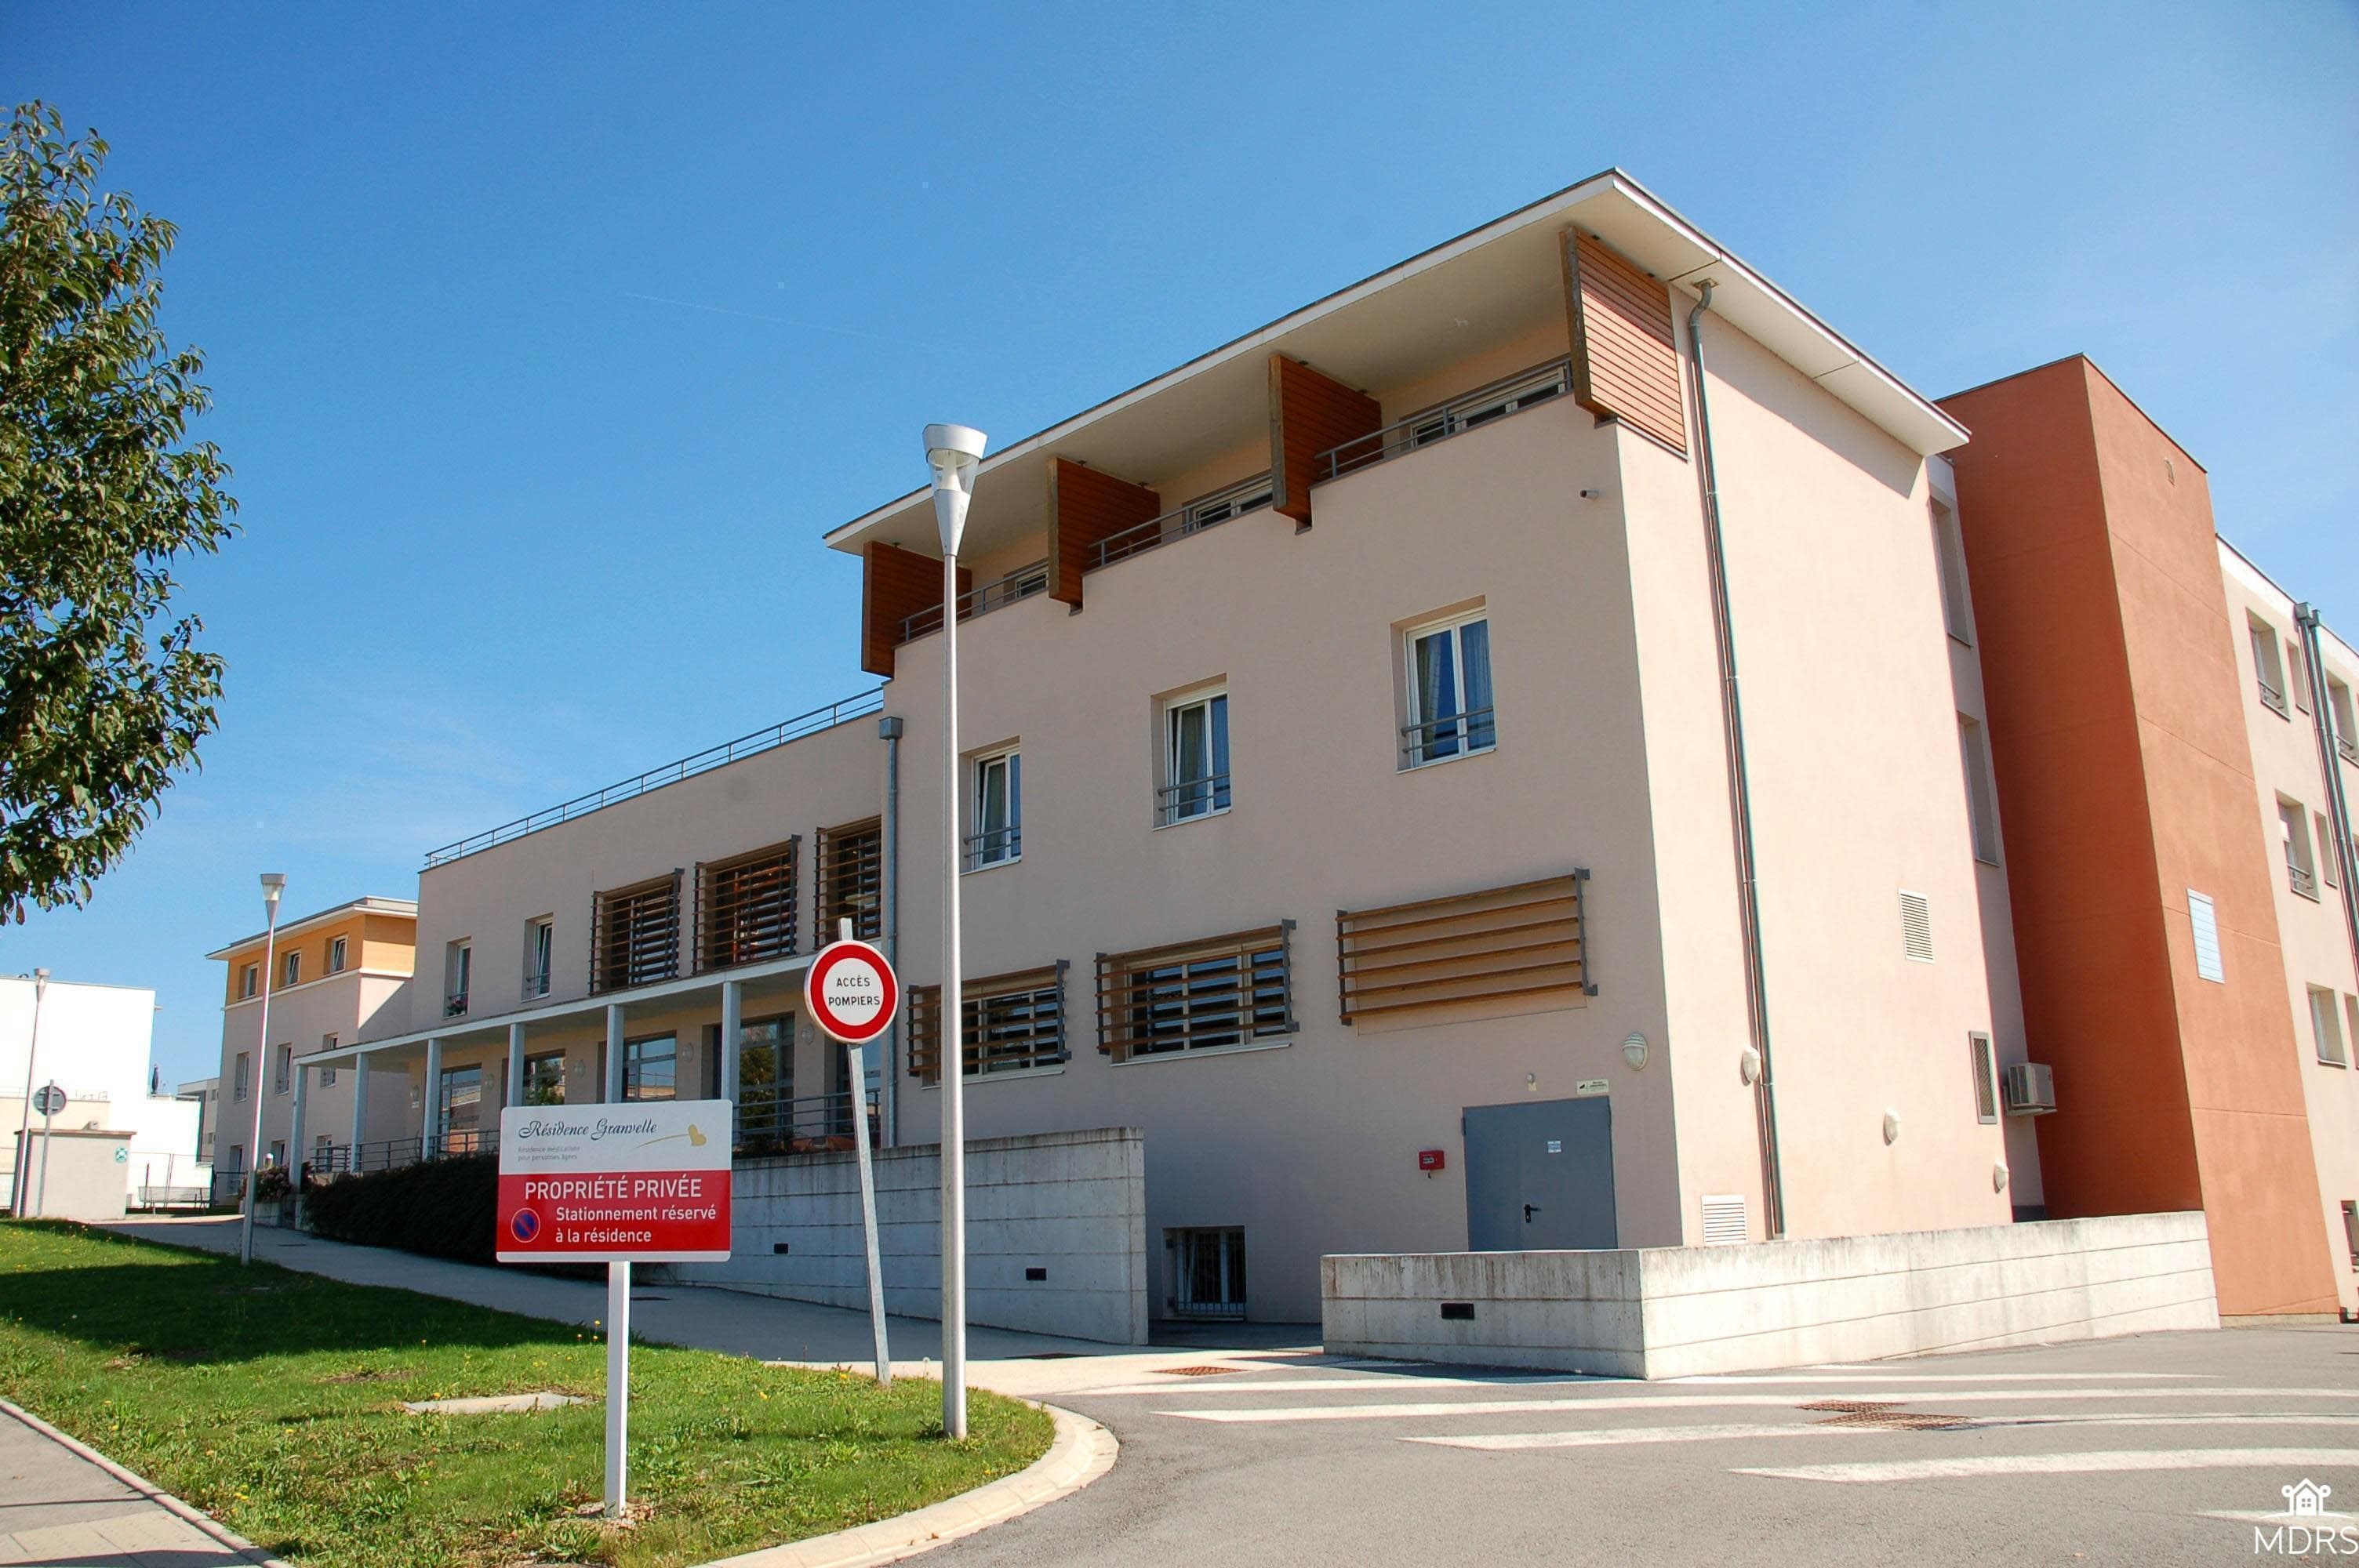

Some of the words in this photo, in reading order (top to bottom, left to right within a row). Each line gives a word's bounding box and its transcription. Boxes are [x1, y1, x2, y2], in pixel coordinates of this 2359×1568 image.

[828, 996, 880, 1007] POMPIERS
[518, 1120, 589, 1138] Résidence
[591, 1117, 658, 1141] Granvelle
[525, 1174, 628, 1200] PROPRIÉTÉ
[634, 1173, 703, 1199] PRIVÉE
[555, 1206, 658, 1221] Stationnement
[661, 1203, 716, 1220] réservé
[555, 1228, 563, 1243] à
[567, 1228, 580, 1243] la
[584, 1227, 652, 1243] résidence
